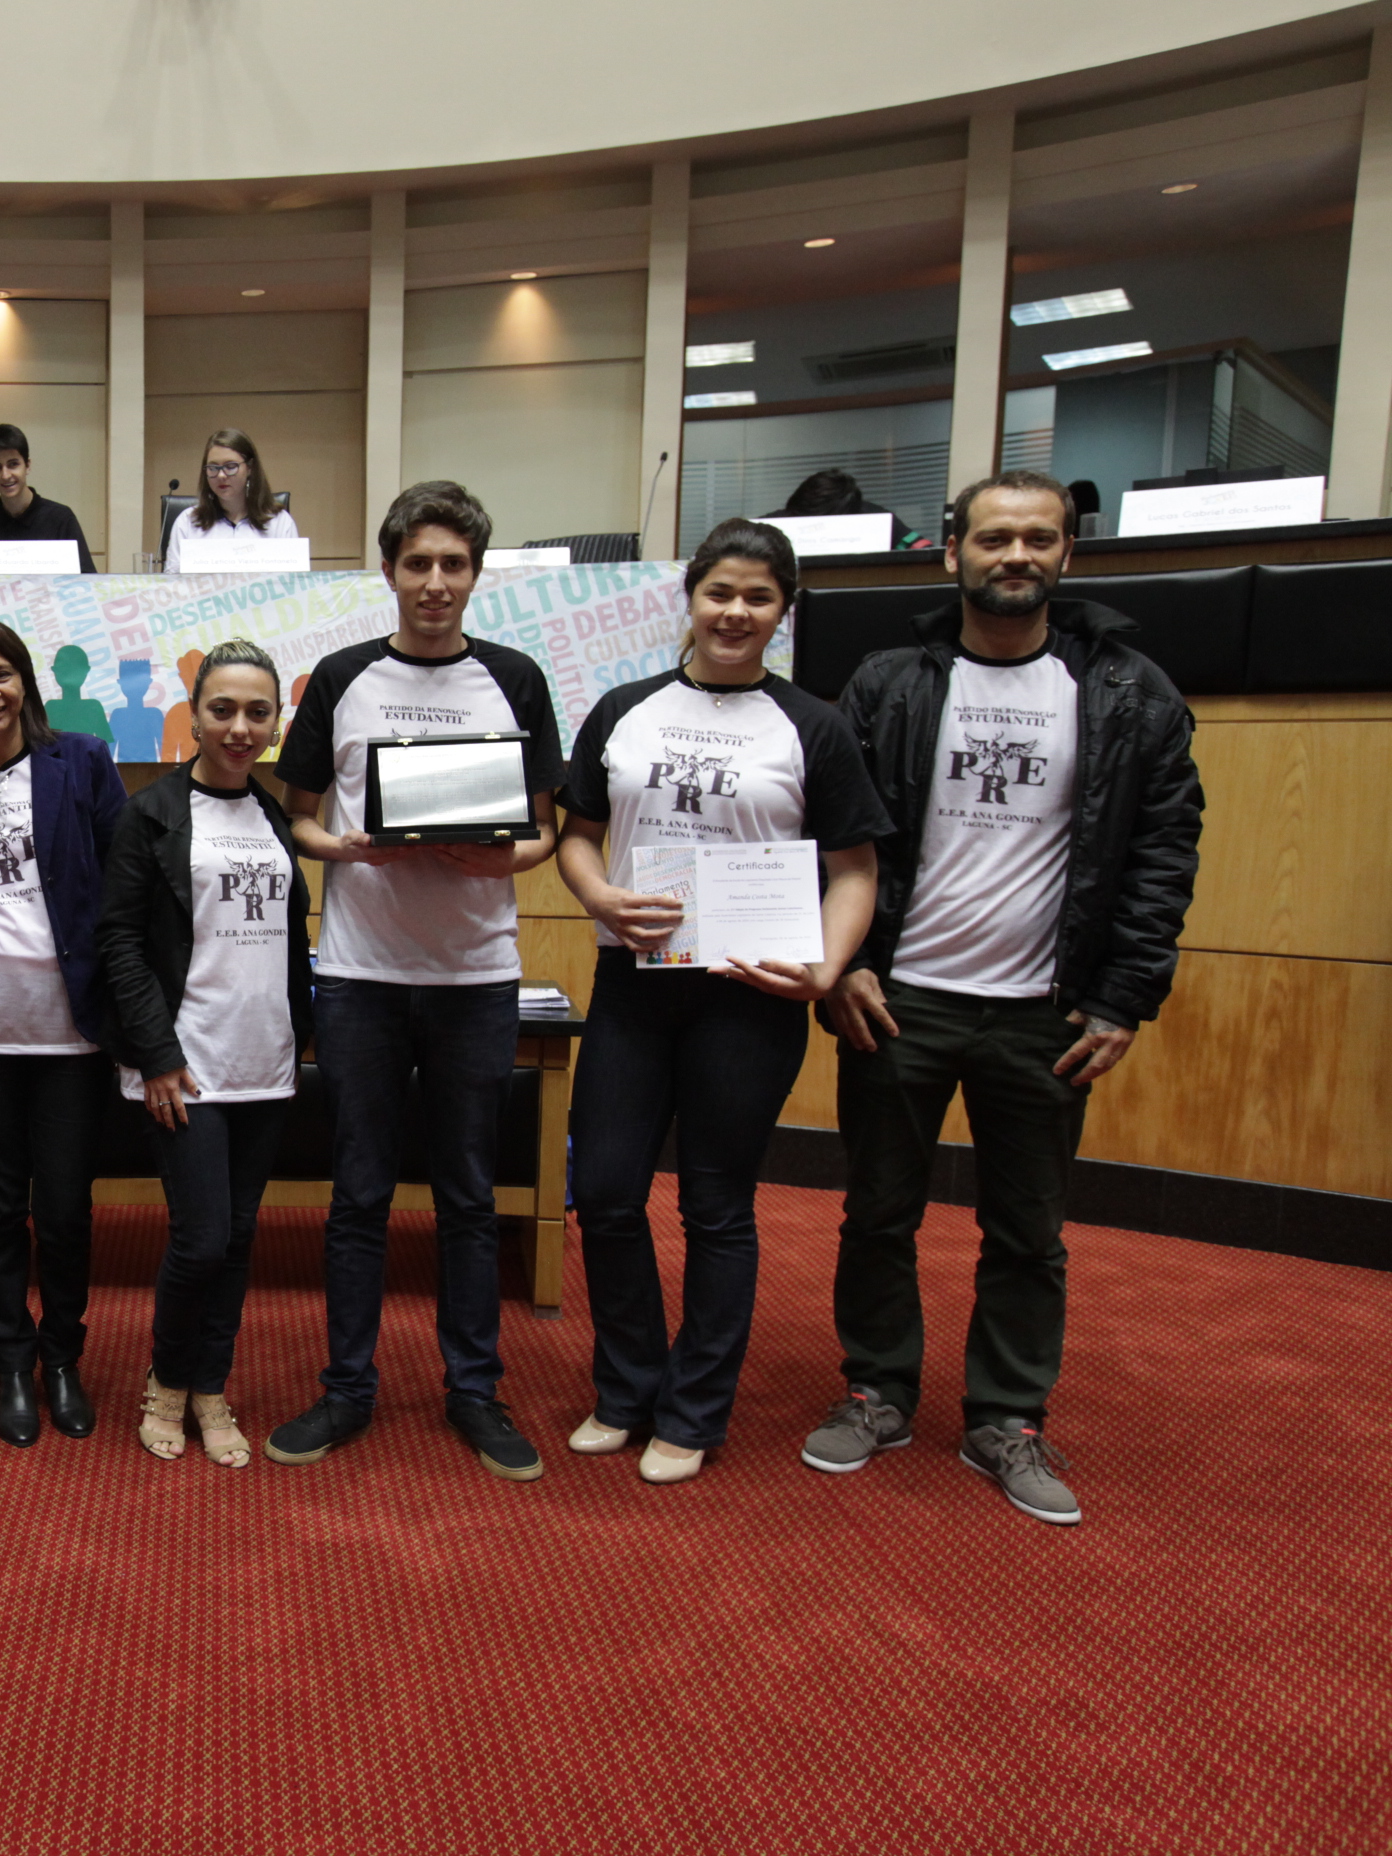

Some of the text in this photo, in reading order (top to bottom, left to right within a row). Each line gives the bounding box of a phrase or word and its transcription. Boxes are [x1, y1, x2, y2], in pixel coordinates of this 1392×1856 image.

[1182, 507, 1225, 520] Gabriel
[1228, 504, 1249, 516] dos
[1253, 502, 1292, 513] Santos
[463, 562, 663, 637] ULTURA
[572, 582, 680, 641] DEBAT
[379, 704, 413, 712] PARTIDO
[426, 707, 472, 717] RENOVAÇÃO
[384, 711, 466, 725] ESTUDANTIL
[957, 712, 1050, 728] ESTUDANTIL
[661, 731, 747, 748] ESTUDANTIL
[971, 811, 993, 821] ANA
[667, 820, 689, 830] ANA
[962, 820, 996, 830] LAGUNA
[658, 829, 707, 841] LAGUNA SC
[213, 841, 276, 850] ESTUDANTIL
[727, 861, 785, 871] Certificado
[0, 890, 18, 900] ANA
[216, 929, 240, 938] E.E.B.
[242, 929, 258, 937] ANA
